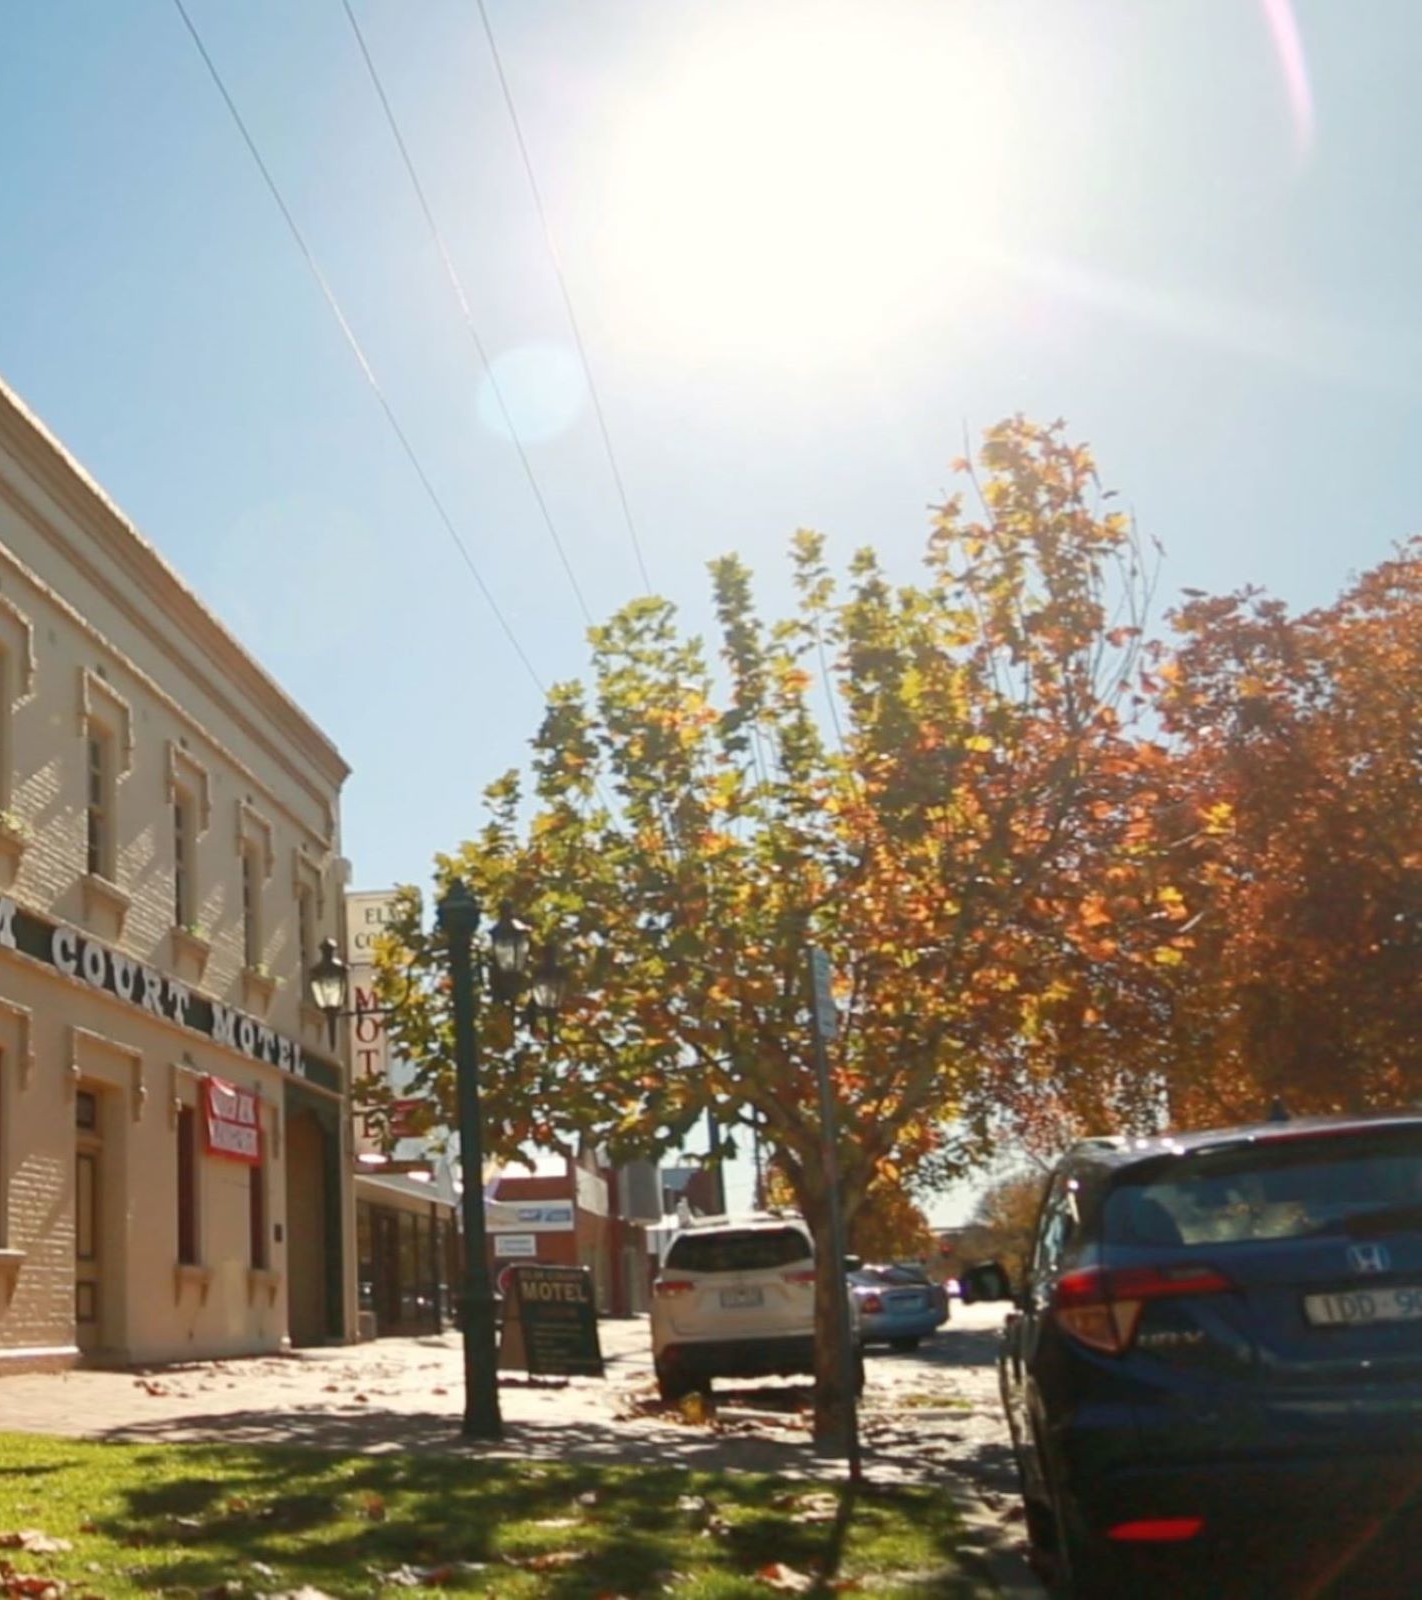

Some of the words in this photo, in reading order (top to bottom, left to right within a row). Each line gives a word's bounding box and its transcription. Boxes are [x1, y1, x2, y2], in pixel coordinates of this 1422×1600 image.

[51, 926, 191, 1027] COURT
[211, 1004, 306, 1077] MOTEL
[354, 986, 380, 1139] MOTL
[521, 1281, 588, 1303] MOTEL
